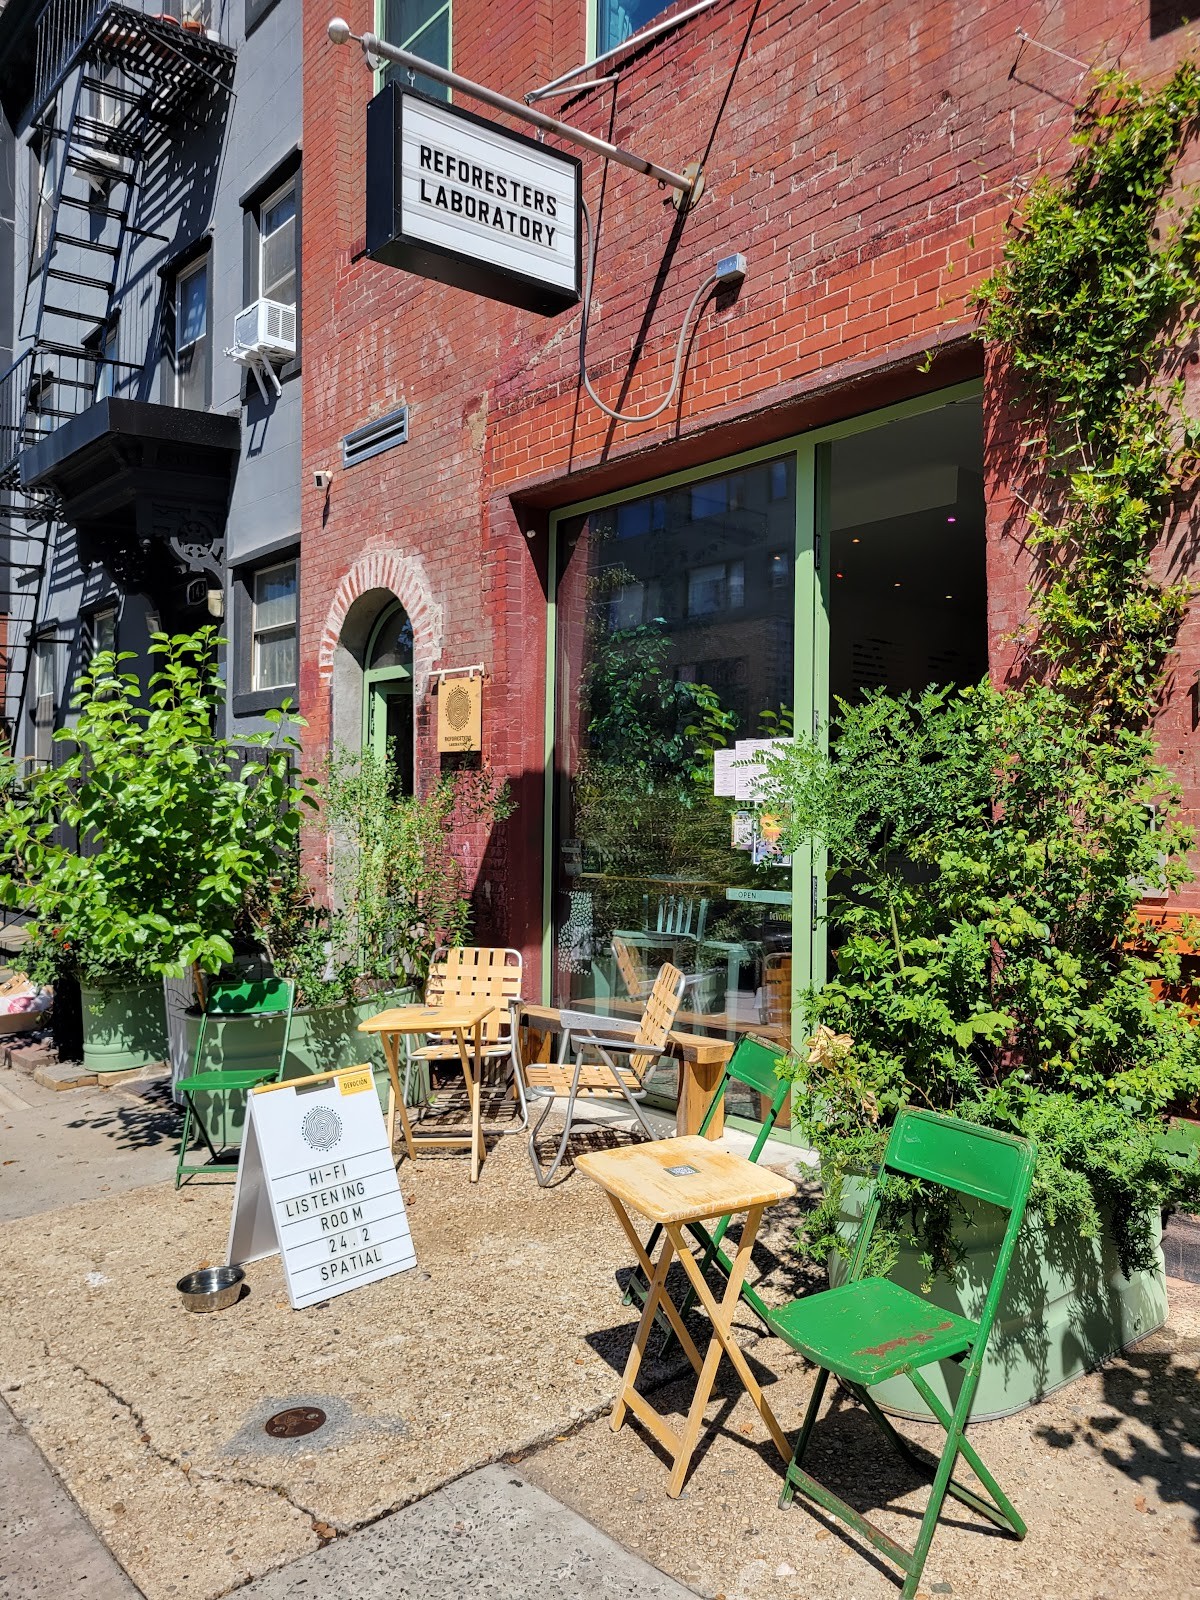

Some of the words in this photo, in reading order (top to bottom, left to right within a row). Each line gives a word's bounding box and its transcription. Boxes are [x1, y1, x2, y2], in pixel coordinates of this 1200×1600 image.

[420, 145, 556, 217] REFORESTERS
[420, 178, 556, 246] LABORATORY
[738, 891, 757, 899] OPEN
[343, 1077, 368, 1090] DEVOCIÓN
[309, 1163, 347, 1186] HI-FI
[286, 1182, 365, 1217] LISTENING
[320, 1207, 364, 1230] ROOM
[320, 1248, 383, 1282] SPATIAL
